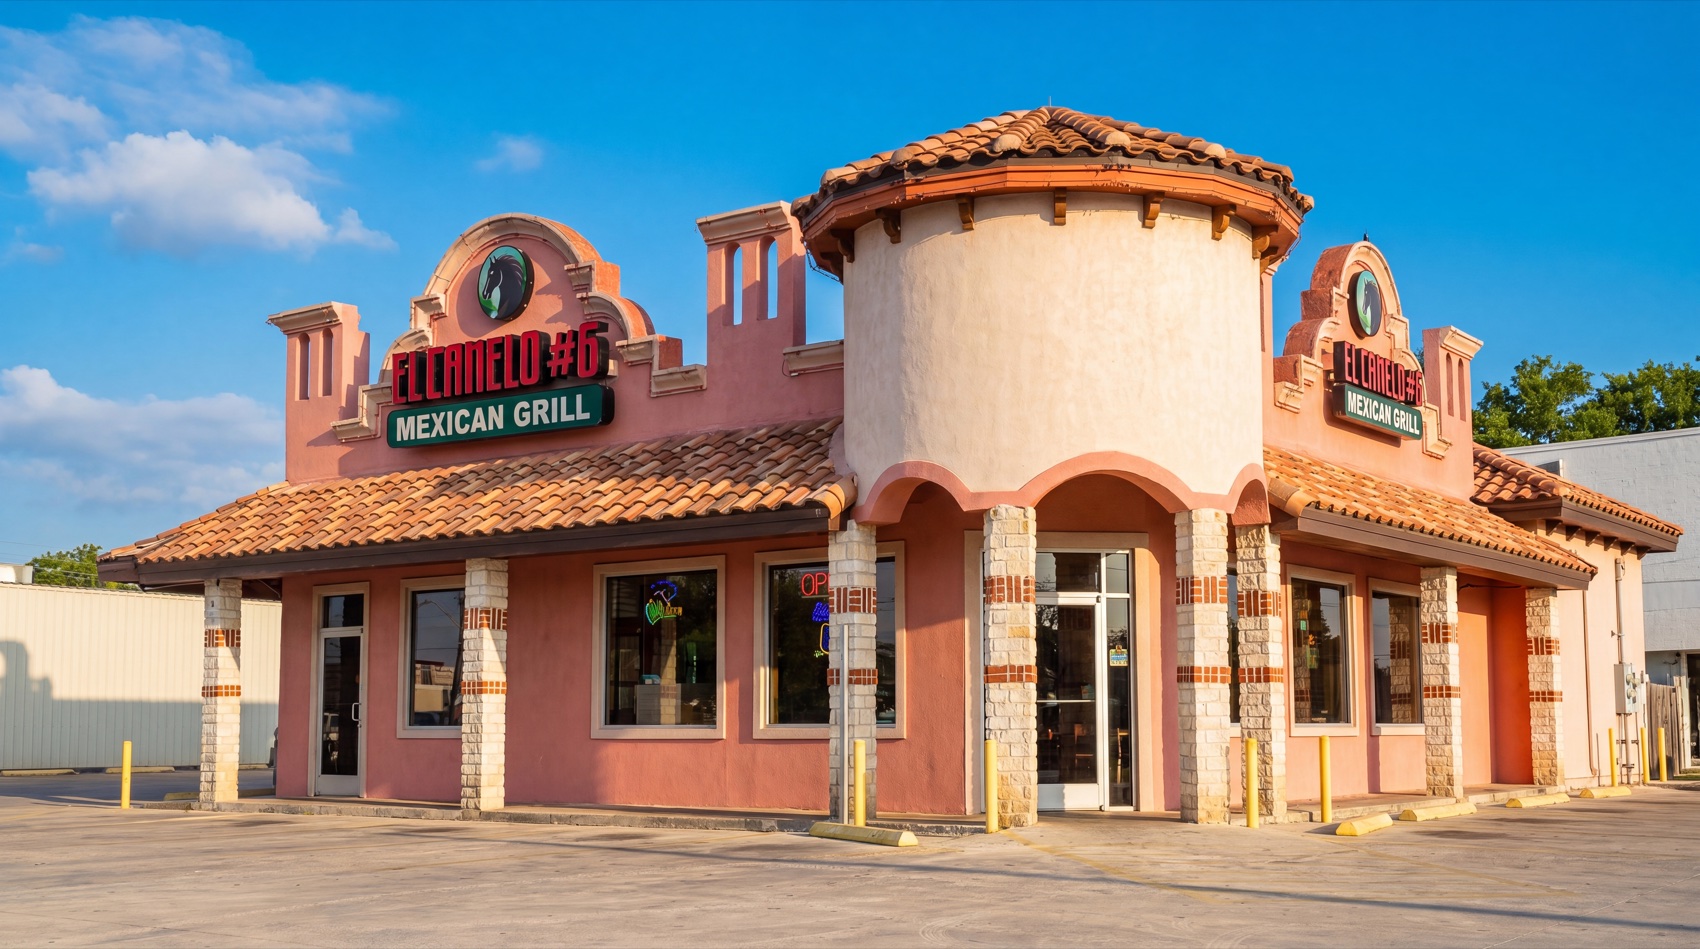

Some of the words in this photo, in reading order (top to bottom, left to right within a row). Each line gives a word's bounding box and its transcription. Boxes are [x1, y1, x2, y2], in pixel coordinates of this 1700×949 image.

[392, 350, 424, 404] EL
[426, 330, 541, 399] CANELO
[547, 321, 600, 378] #6
[1344, 341, 1359, 385] EL
[1406, 370, 1422, 407] #6
[396, 404, 505, 442] MEXICAN
[513, 394, 591, 426] GRILL
[1347, 390, 1392, 426] MEXICAN
[1393, 407, 1420, 436] GRILL
